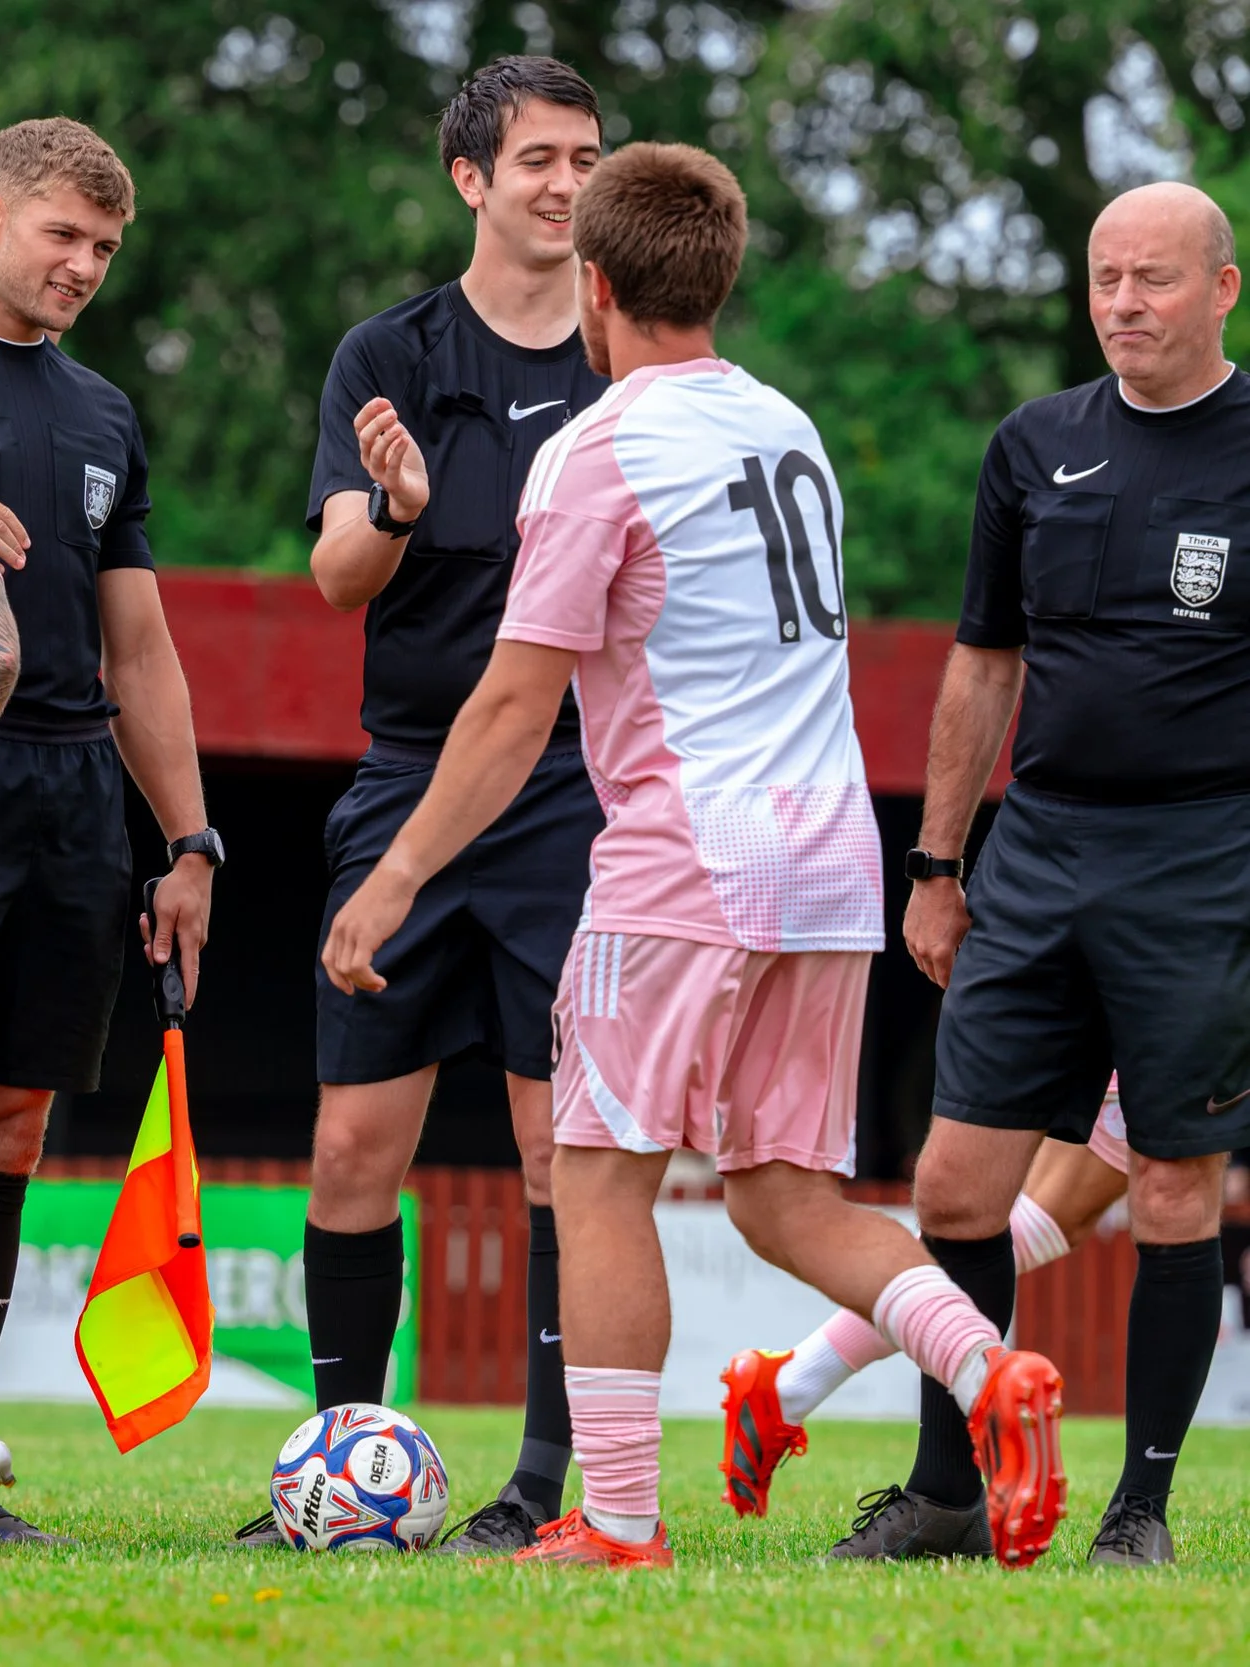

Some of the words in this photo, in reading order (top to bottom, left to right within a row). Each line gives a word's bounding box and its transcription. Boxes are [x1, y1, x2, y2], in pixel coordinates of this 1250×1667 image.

[726, 449, 847, 644] 10
[1172, 607, 1211, 621] REFEREE
[369, 1443, 389, 1485] DELTA
[302, 1472, 326, 1539] Mitre
